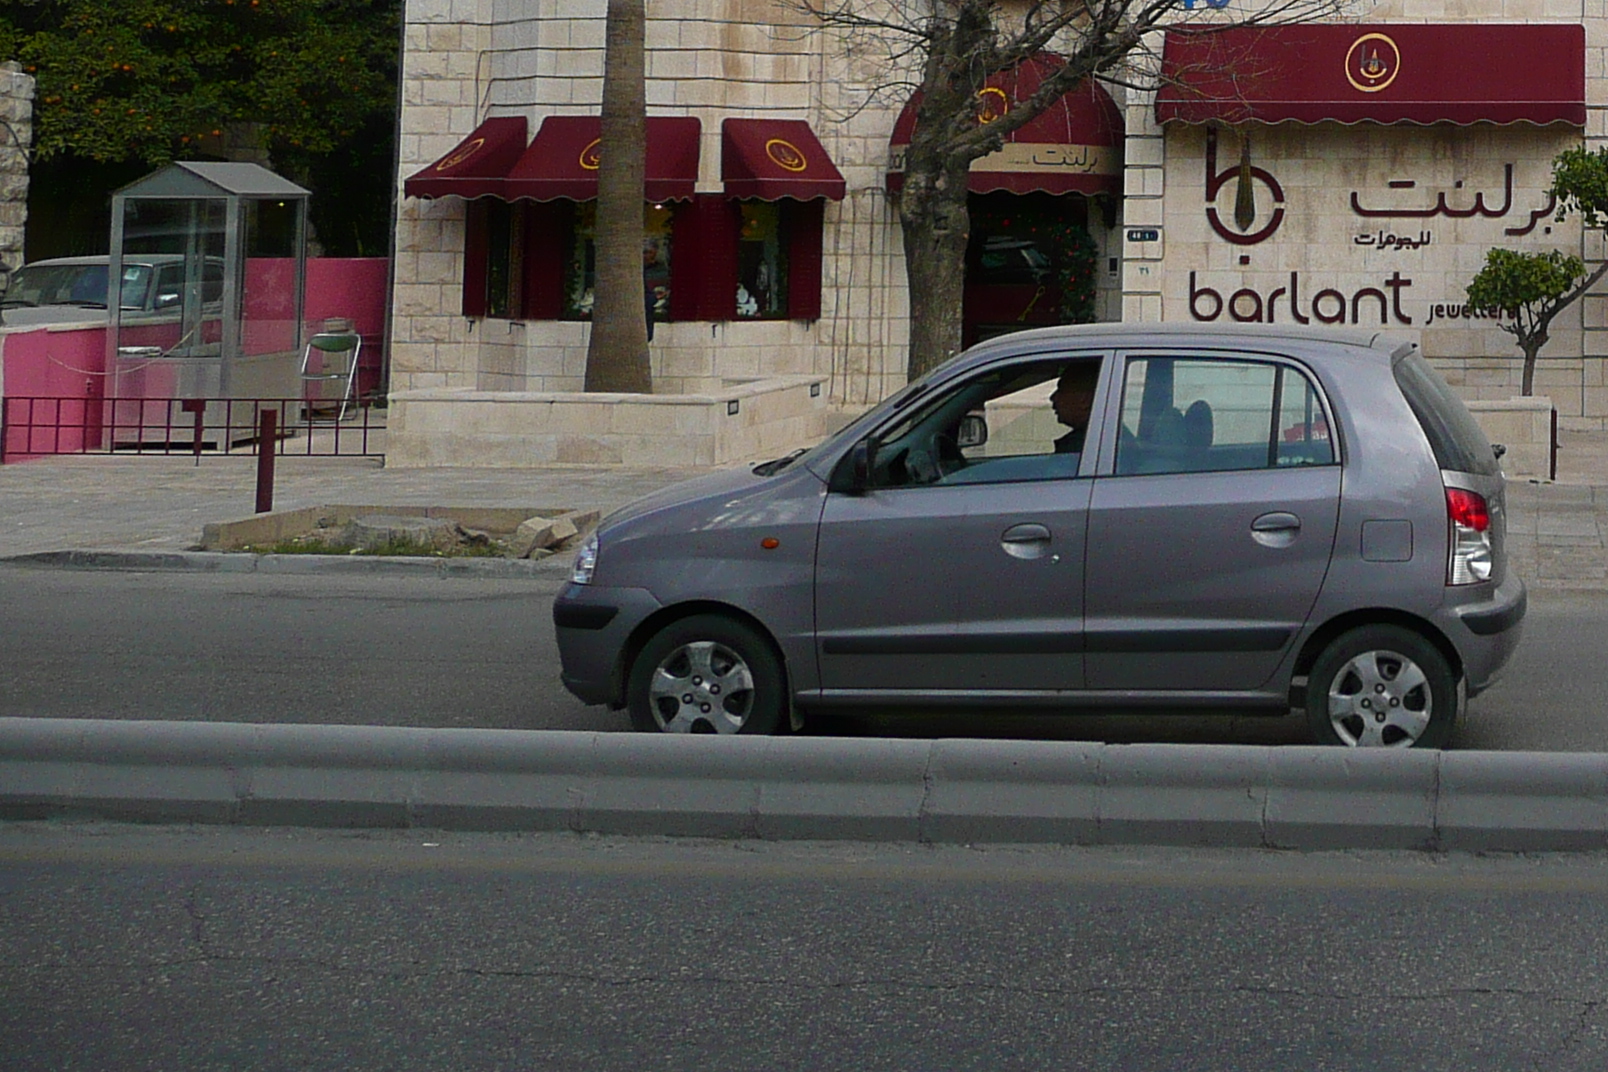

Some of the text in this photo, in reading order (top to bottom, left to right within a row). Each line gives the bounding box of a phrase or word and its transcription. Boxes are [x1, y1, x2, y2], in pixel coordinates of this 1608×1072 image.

[1033, 147, 1098, 174] برلنت
[1350, 163, 1557, 236] برلنت
[1354, 230, 1431, 250] للمجوهرات
[1189, 270, 1412, 325] barlant
